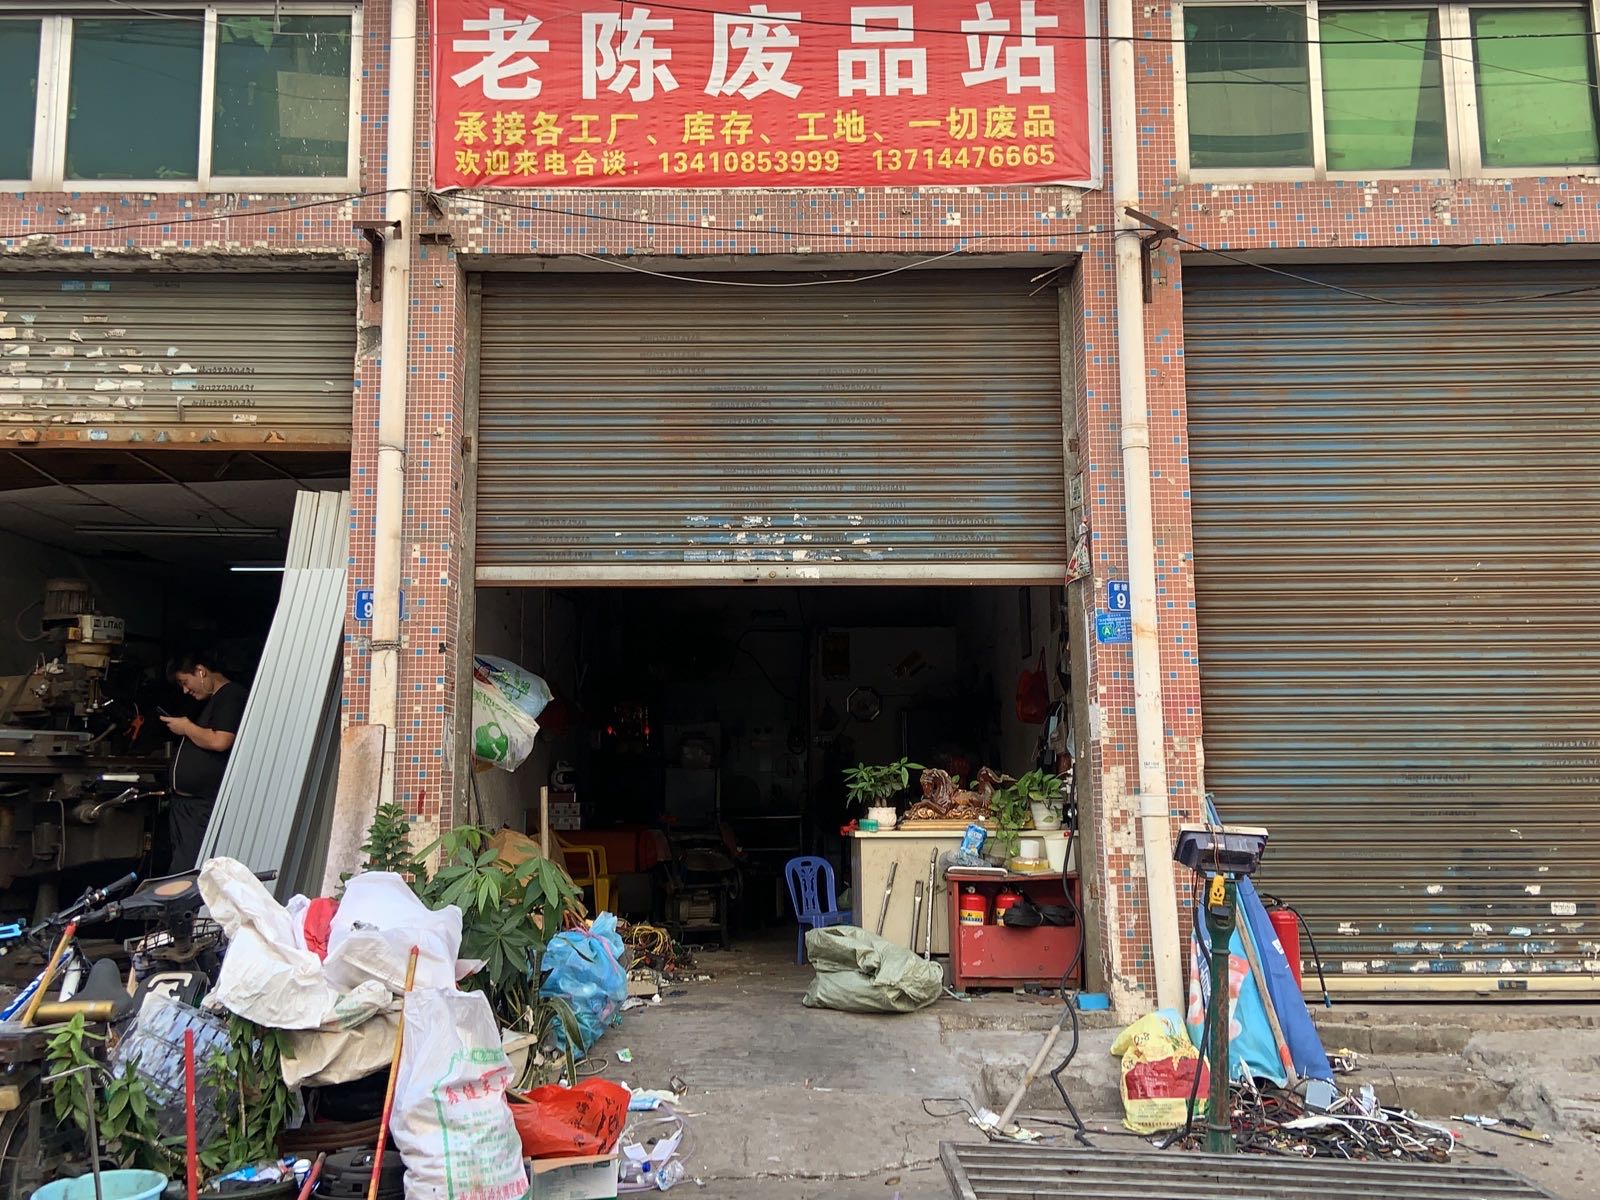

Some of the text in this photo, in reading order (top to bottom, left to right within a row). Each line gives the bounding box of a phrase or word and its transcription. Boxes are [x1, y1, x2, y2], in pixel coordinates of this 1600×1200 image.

[451, 2, 1060, 102] 老陈废品站
[453, 104, 1056, 146] 承接各工厂、库存、工地、一切废品
[658, 150, 840, 174] 13410853999
[872, 144, 1056, 171] 13714476665
[364, 602, 373, 618] 9
[1116, 592, 1127, 609] 9
